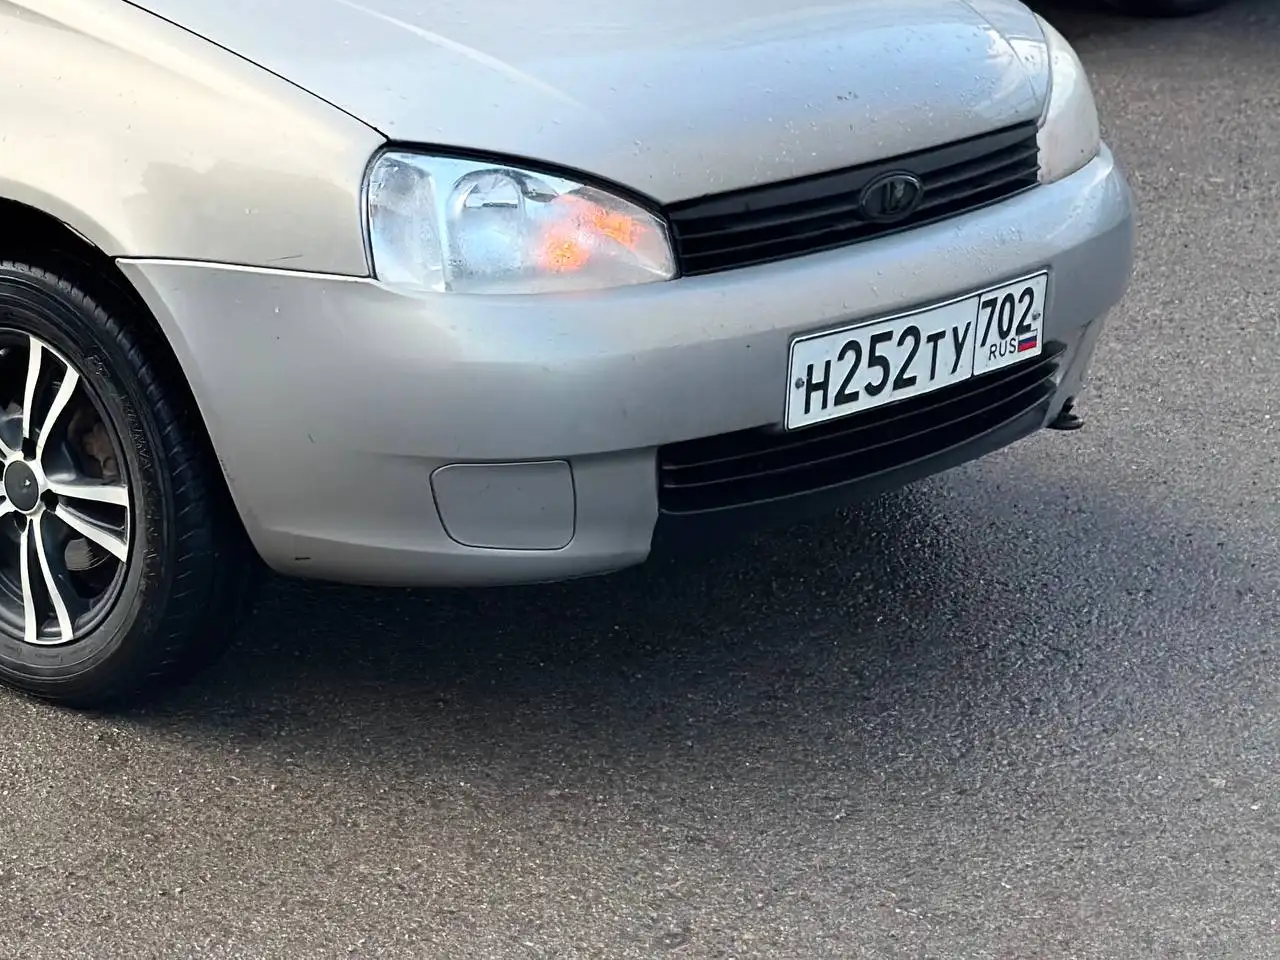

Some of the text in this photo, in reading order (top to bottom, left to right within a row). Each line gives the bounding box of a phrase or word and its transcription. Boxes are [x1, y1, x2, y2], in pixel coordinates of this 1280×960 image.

[804, 287, 1035, 415] Н252ТУ 702
[988, 337, 1017, 361] RUS
